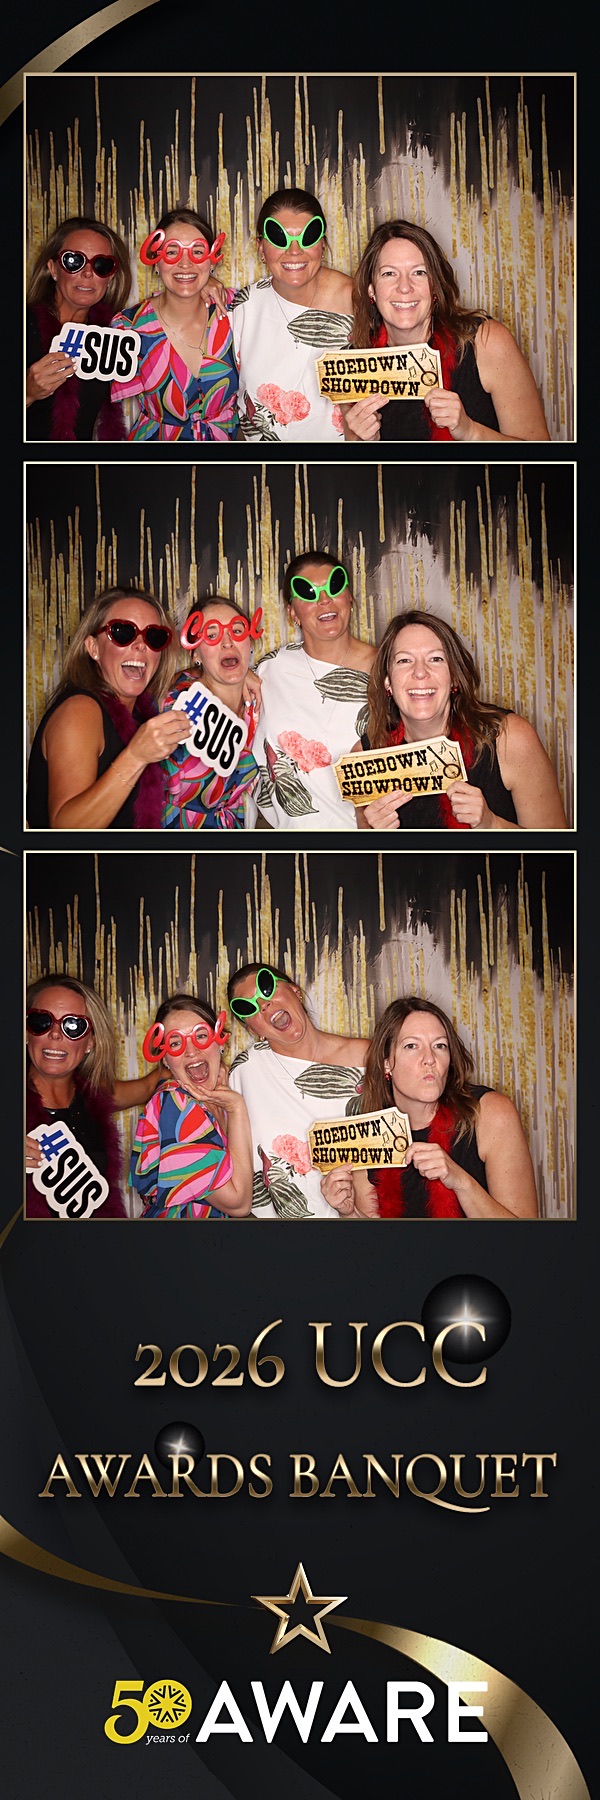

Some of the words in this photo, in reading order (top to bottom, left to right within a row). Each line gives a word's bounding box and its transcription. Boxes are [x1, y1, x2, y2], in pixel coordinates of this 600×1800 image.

[140, 228, 226, 266] Cool
[58, 329, 136, 376] #SUS
[323, 354, 408, 376] HOEDOWN
[320, 377, 420, 396] SHOWDOWN
[180, 607, 265, 650] Cool
[181, 691, 243, 770] #SUS
[341, 749, 428, 780] HOEDOWN
[341, 775, 444, 796] SHOWDOWN
[142, 1010, 231, 1063] Cool
[313, 1119, 382, 1146] HOEDOWN
[312, 1147, 394, 1164] SHOWDOWN
[36, 1129, 103, 1218] #SUS
